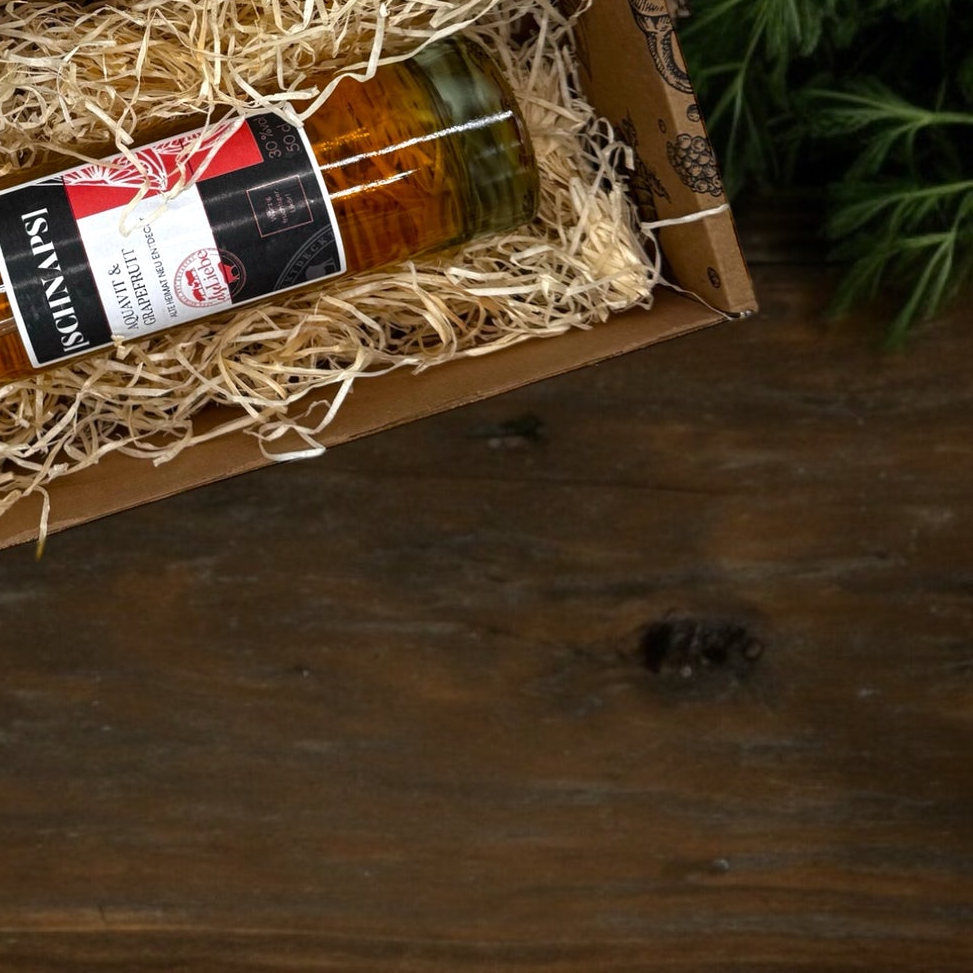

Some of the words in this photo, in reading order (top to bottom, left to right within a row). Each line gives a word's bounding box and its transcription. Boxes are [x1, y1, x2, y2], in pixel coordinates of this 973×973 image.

[265, 141, 282, 159] 30
[283, 134, 300, 152] 50
[108, 263, 121, 276] &
[153, 260, 166, 277] NEU
[21, 208, 90, 352] [SCHNAPS]
[121, 248, 156, 326] GRAPEFRUIT
[159, 279, 174, 306] HEIMAT
[111, 280, 139, 331] AQUAVIT
[167, 305, 178, 318] ALTE
